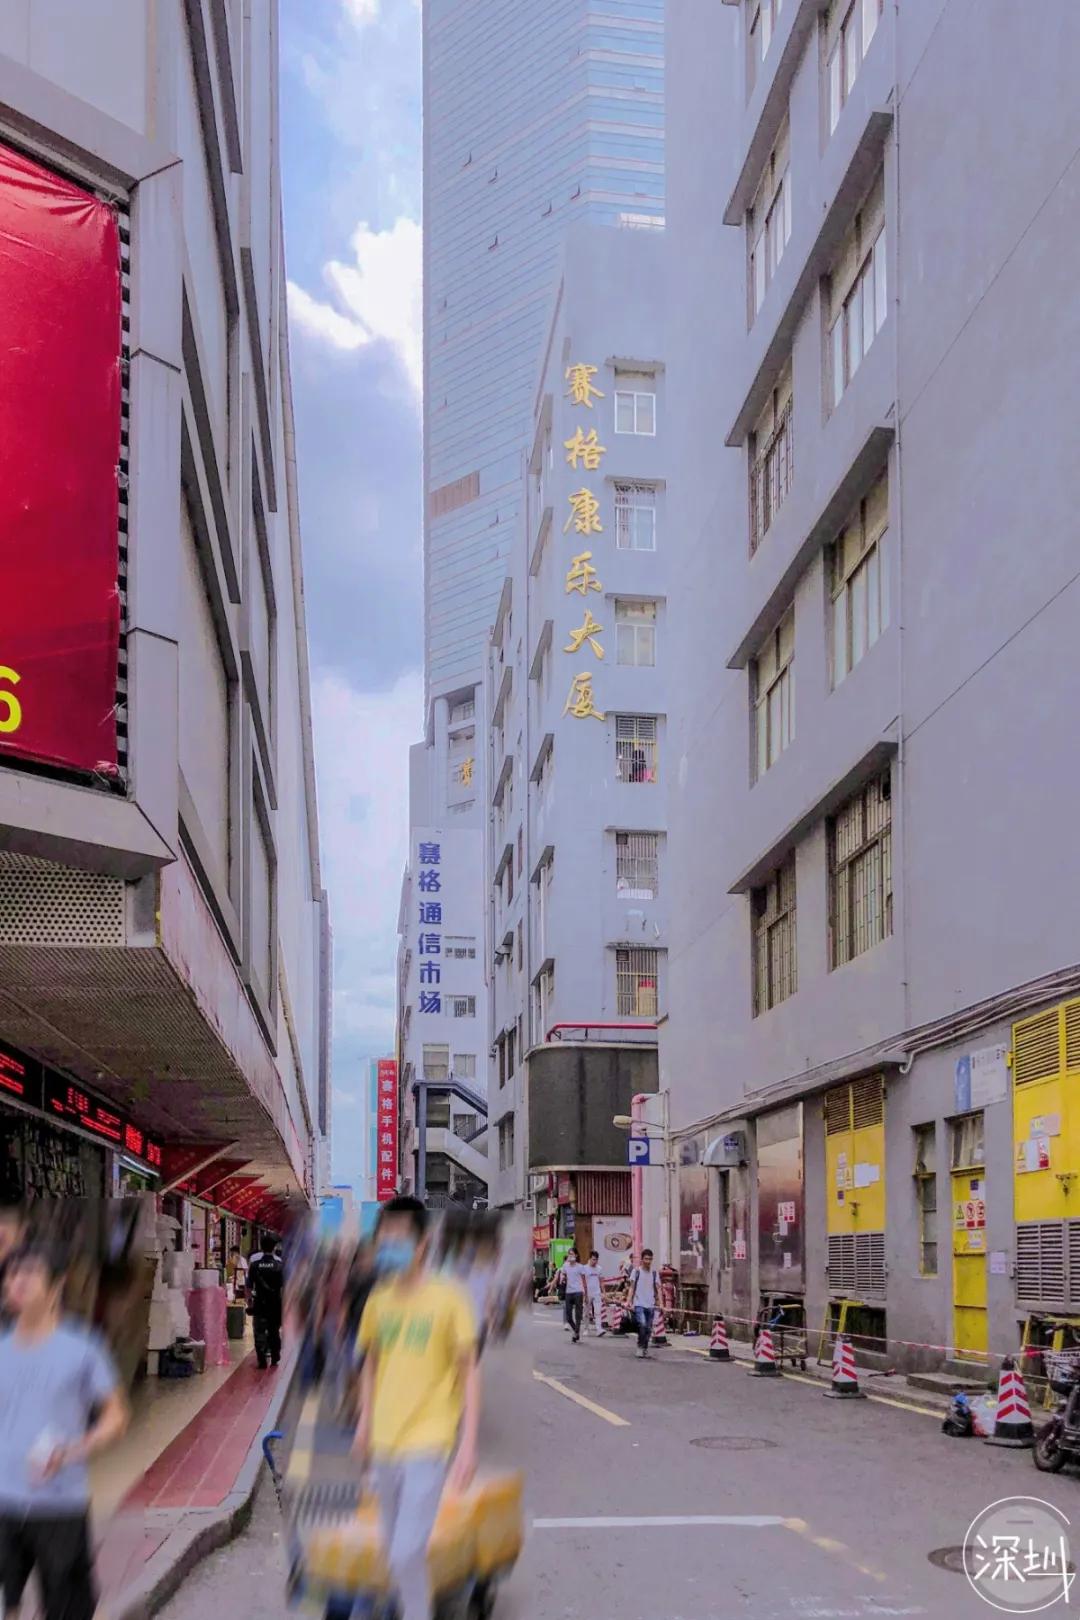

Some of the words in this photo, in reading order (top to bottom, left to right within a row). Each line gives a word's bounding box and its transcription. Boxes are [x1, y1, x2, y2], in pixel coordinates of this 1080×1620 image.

[562, 362, 606, 721] 赛格康乐大厦
[418, 842, 442, 1014] 赛格通信市场
[381, 1079, 394, 1181] 赛格手机配件
[629, 1140, 648, 1163] P
